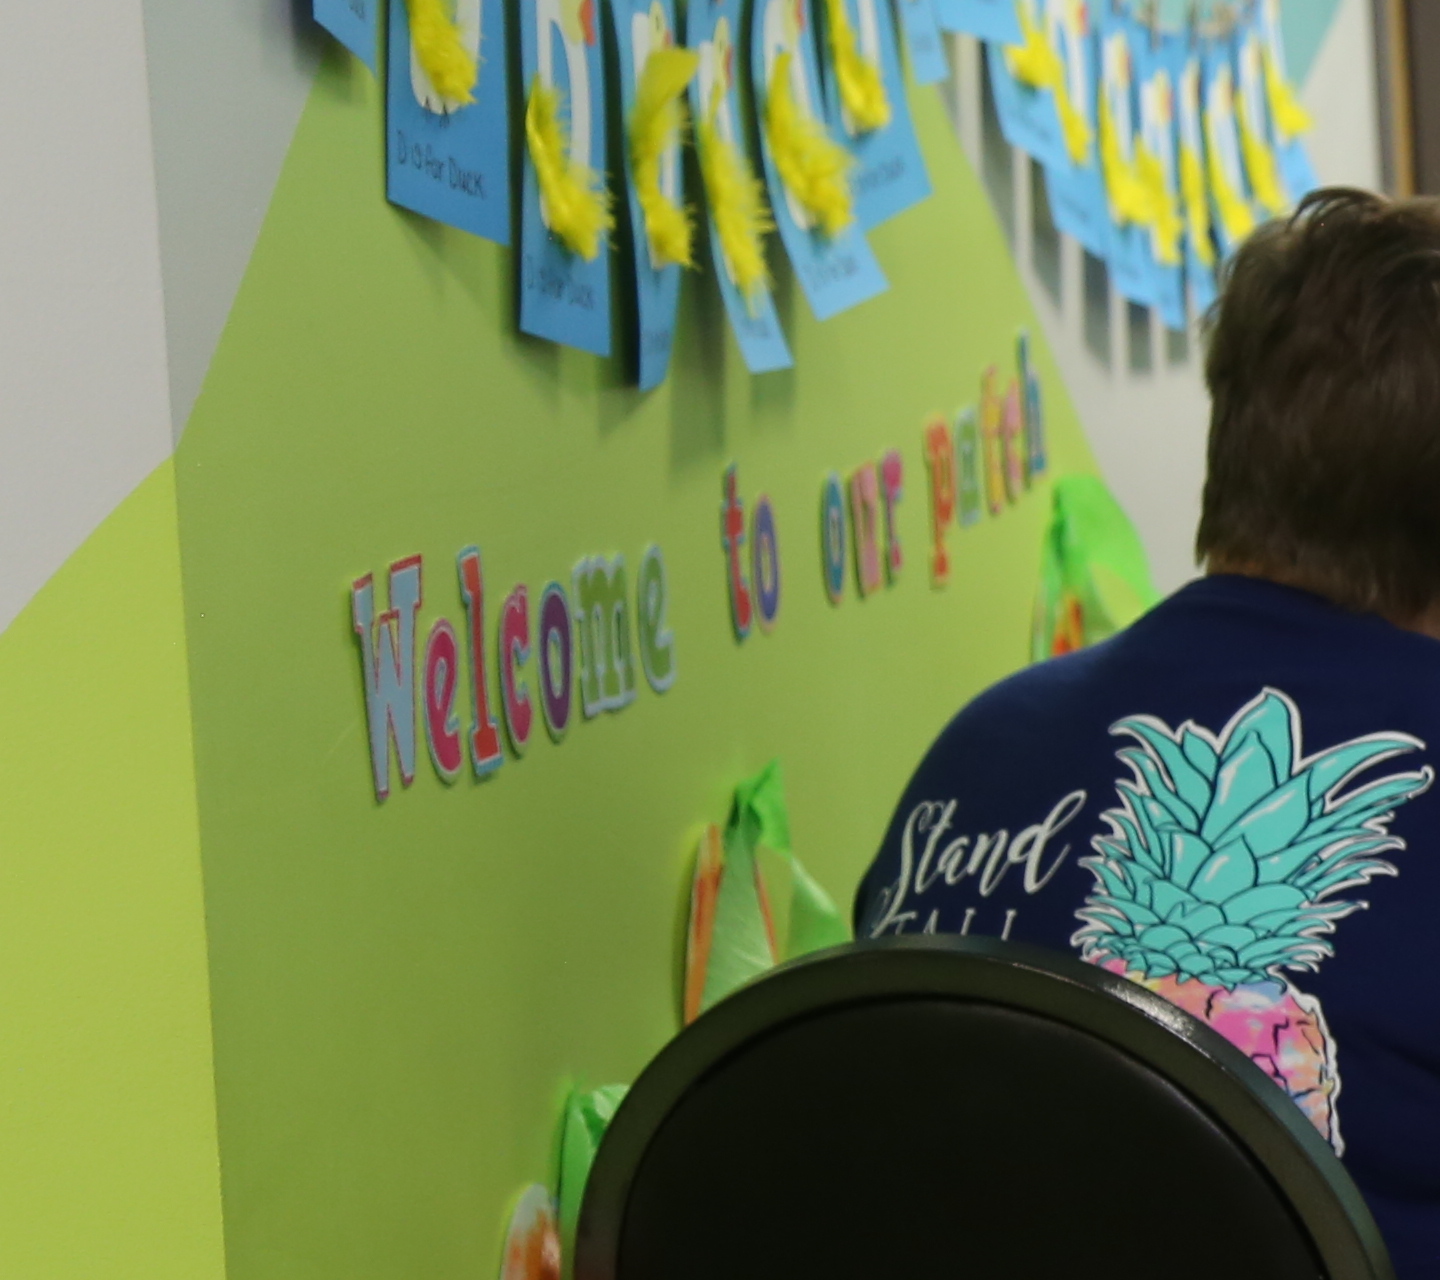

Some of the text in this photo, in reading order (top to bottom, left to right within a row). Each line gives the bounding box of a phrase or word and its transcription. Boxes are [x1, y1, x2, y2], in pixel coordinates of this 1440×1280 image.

[352, 543, 677, 802] Welcome
[721, 462, 780, 641] to
[822, 448, 903, 605] our
[869, 788, 1087, 940] Stand
